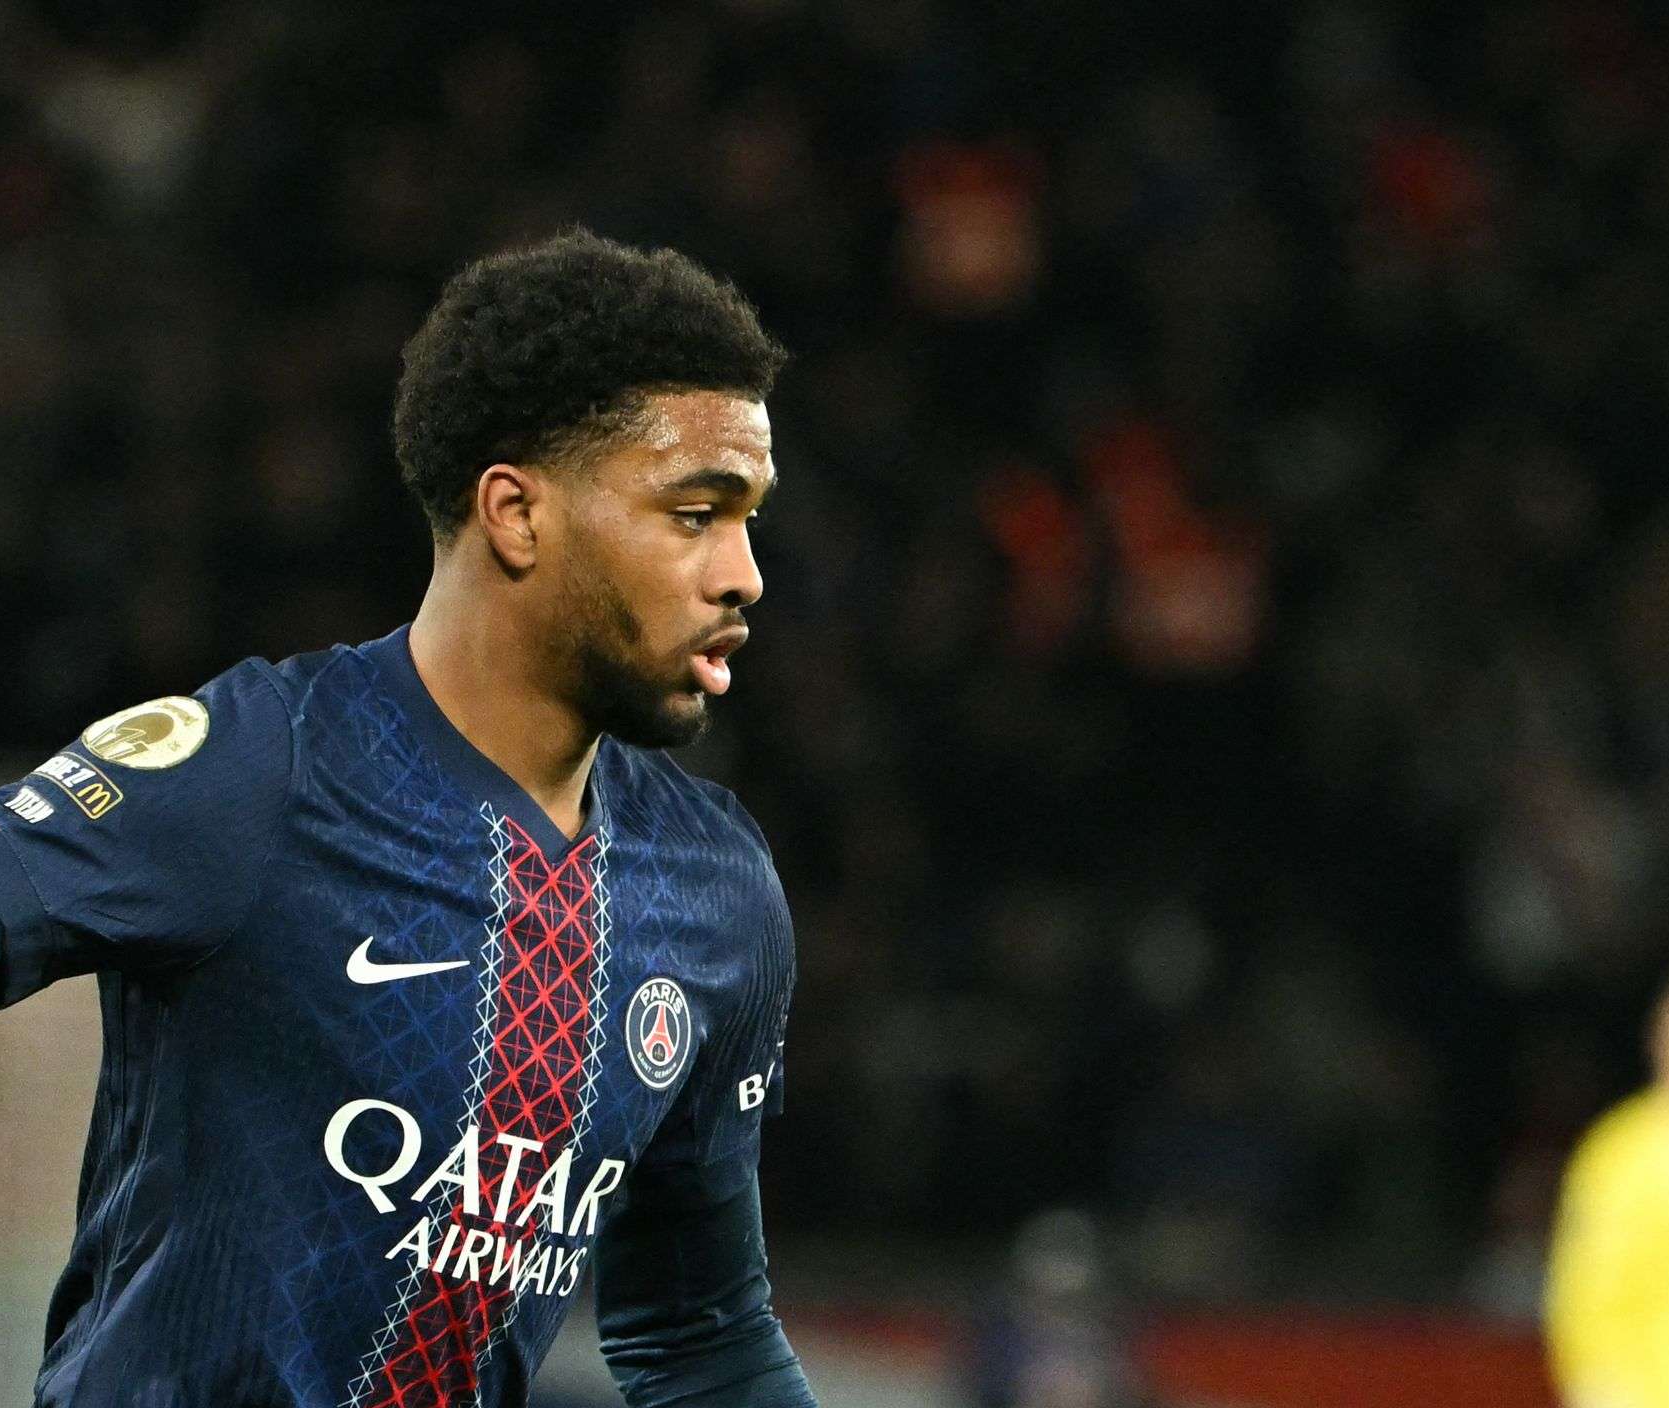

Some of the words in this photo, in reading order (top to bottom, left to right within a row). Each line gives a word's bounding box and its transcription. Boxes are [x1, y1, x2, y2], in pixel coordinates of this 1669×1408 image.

[639, 983, 684, 1015] PARIS
[323, 1098, 626, 1237] QATAR
[384, 1215, 588, 1297] AIRWAYS
